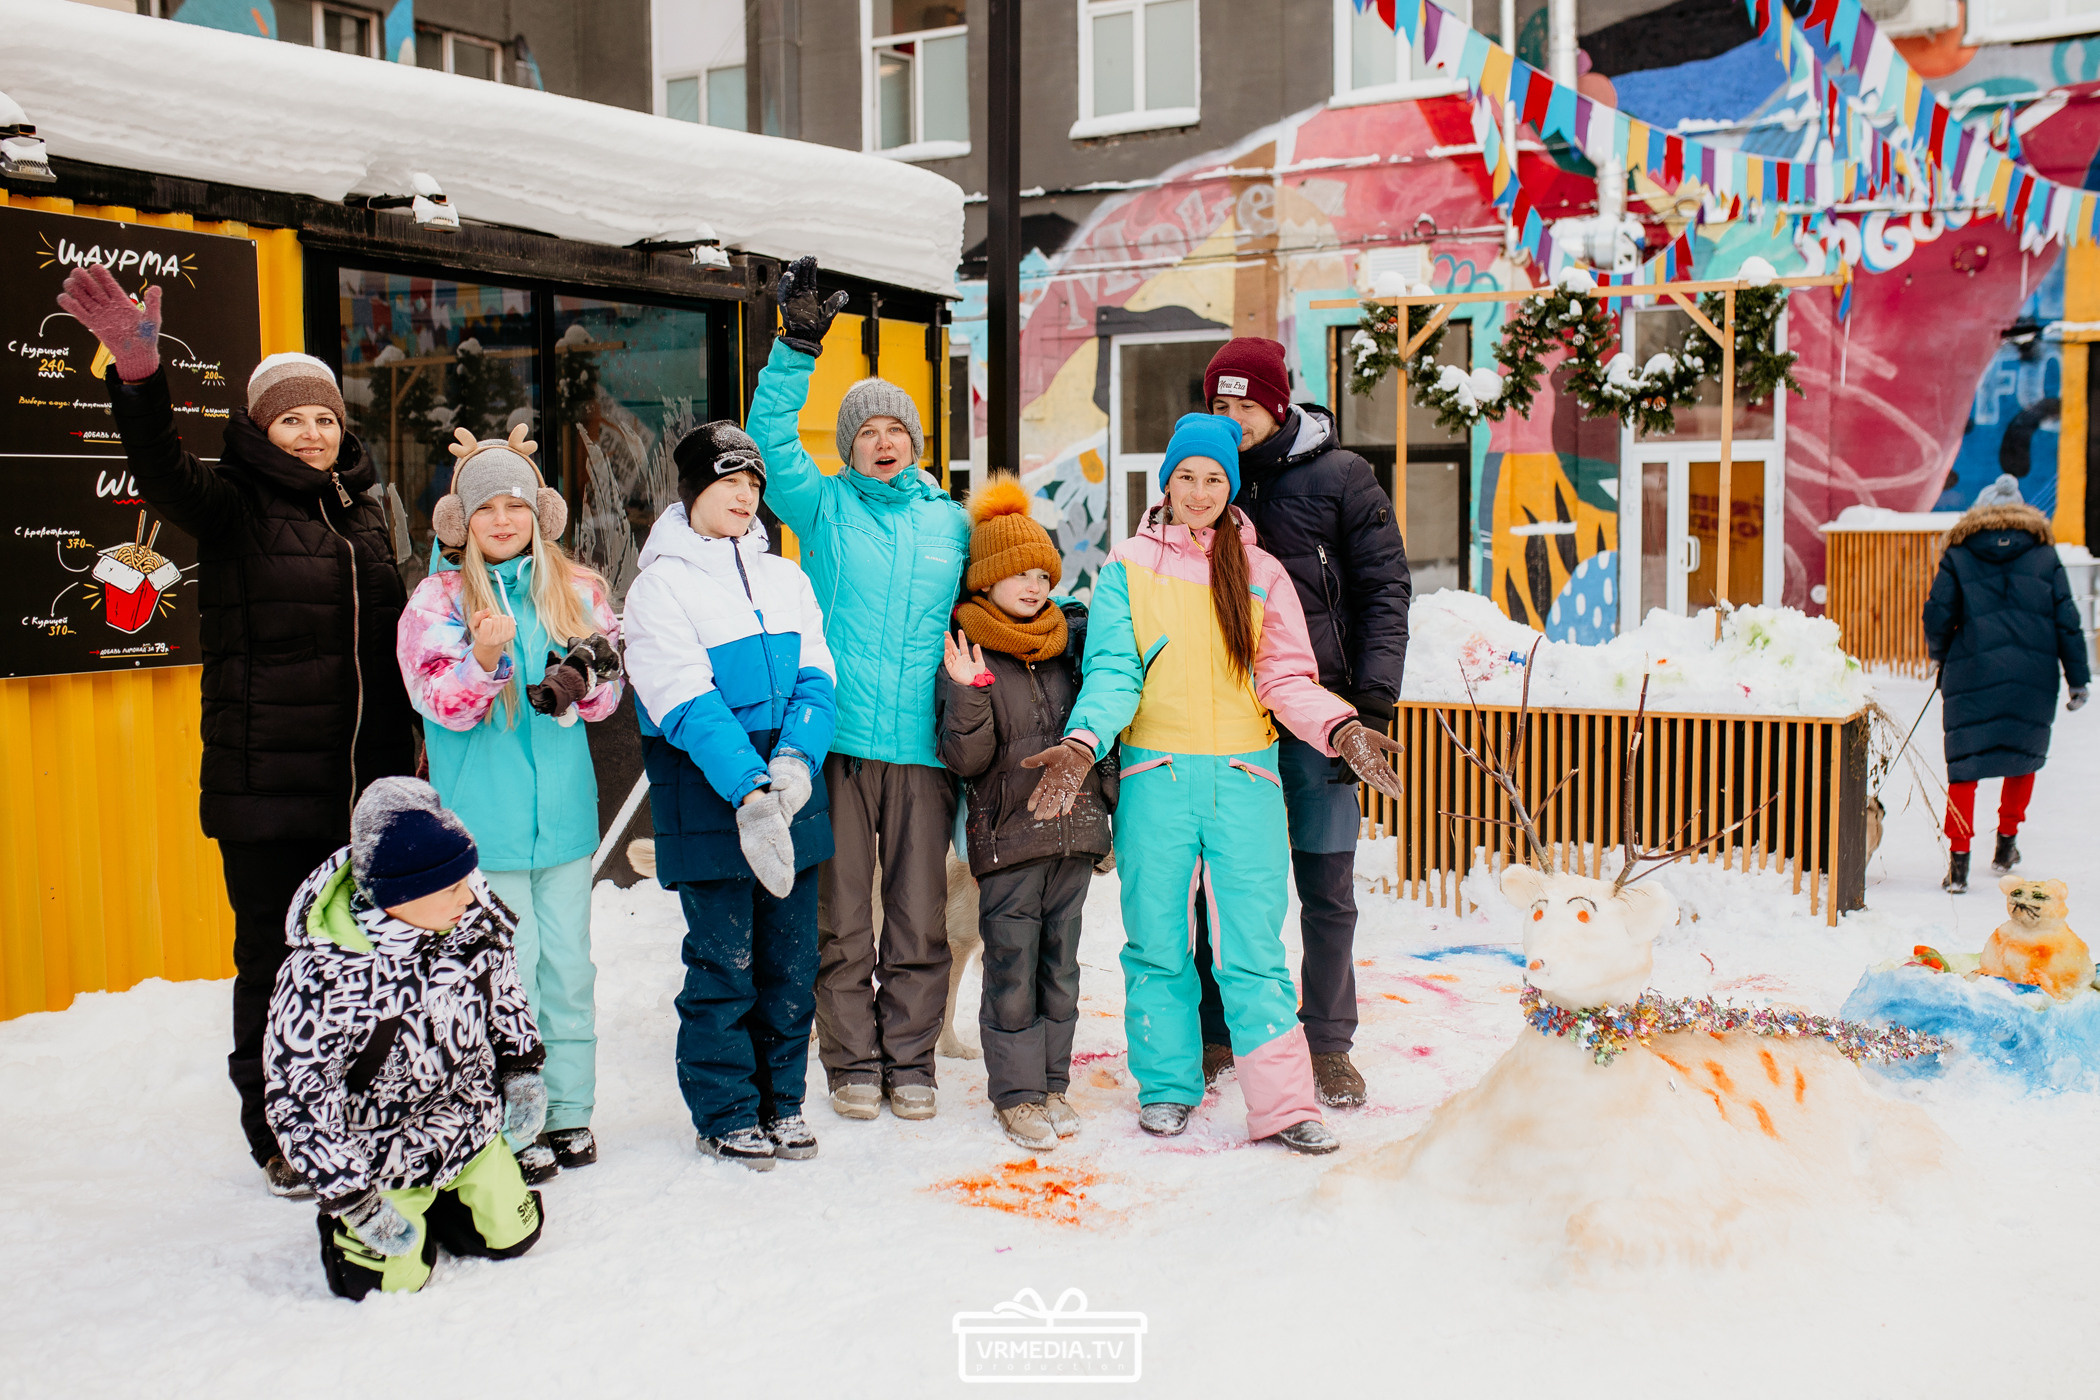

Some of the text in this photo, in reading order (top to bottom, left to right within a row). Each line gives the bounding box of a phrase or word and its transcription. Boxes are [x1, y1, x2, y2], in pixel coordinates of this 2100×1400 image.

[58, 238, 180, 278] ШАУРМА
[20, 342, 70, 359] курицей
[1233, 381, 1246, 391] Era
